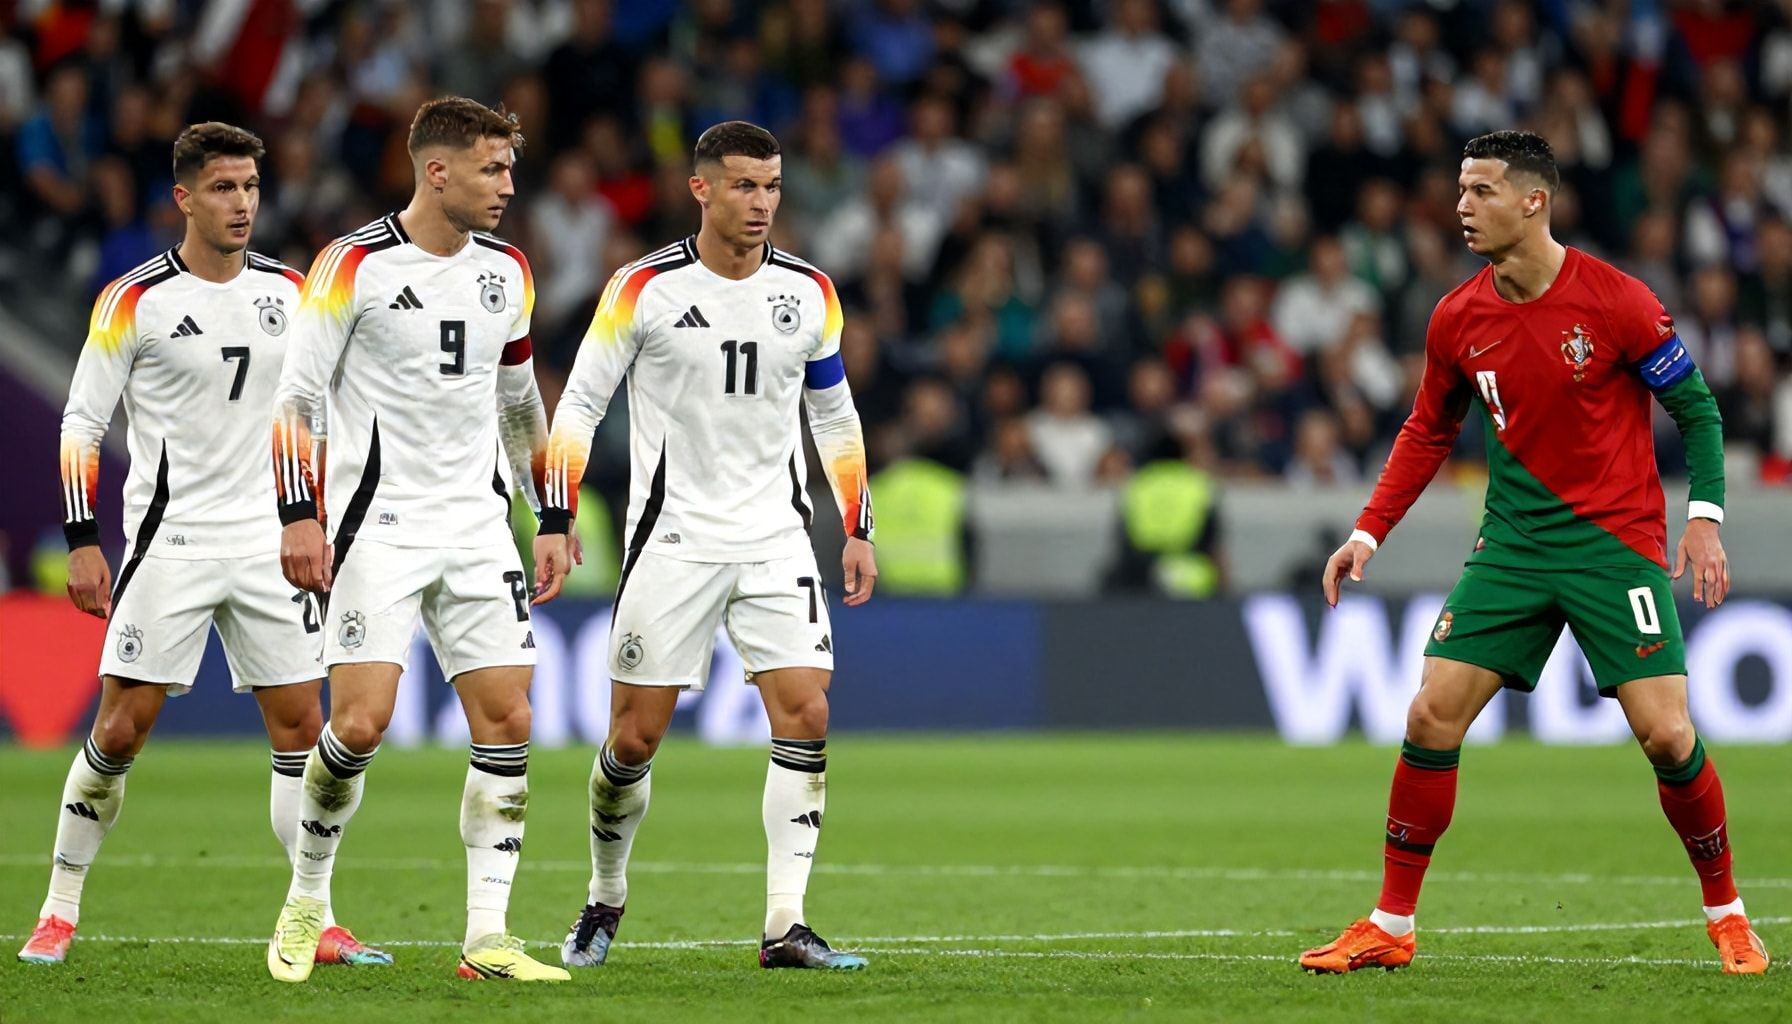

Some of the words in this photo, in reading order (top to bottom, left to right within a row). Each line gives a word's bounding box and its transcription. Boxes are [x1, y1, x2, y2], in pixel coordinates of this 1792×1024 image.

[220, 346, 251, 401] 7
[439, 320, 465, 376] 9
[720, 340, 758, 395] 11
[1627, 586, 1662, 634] 0
